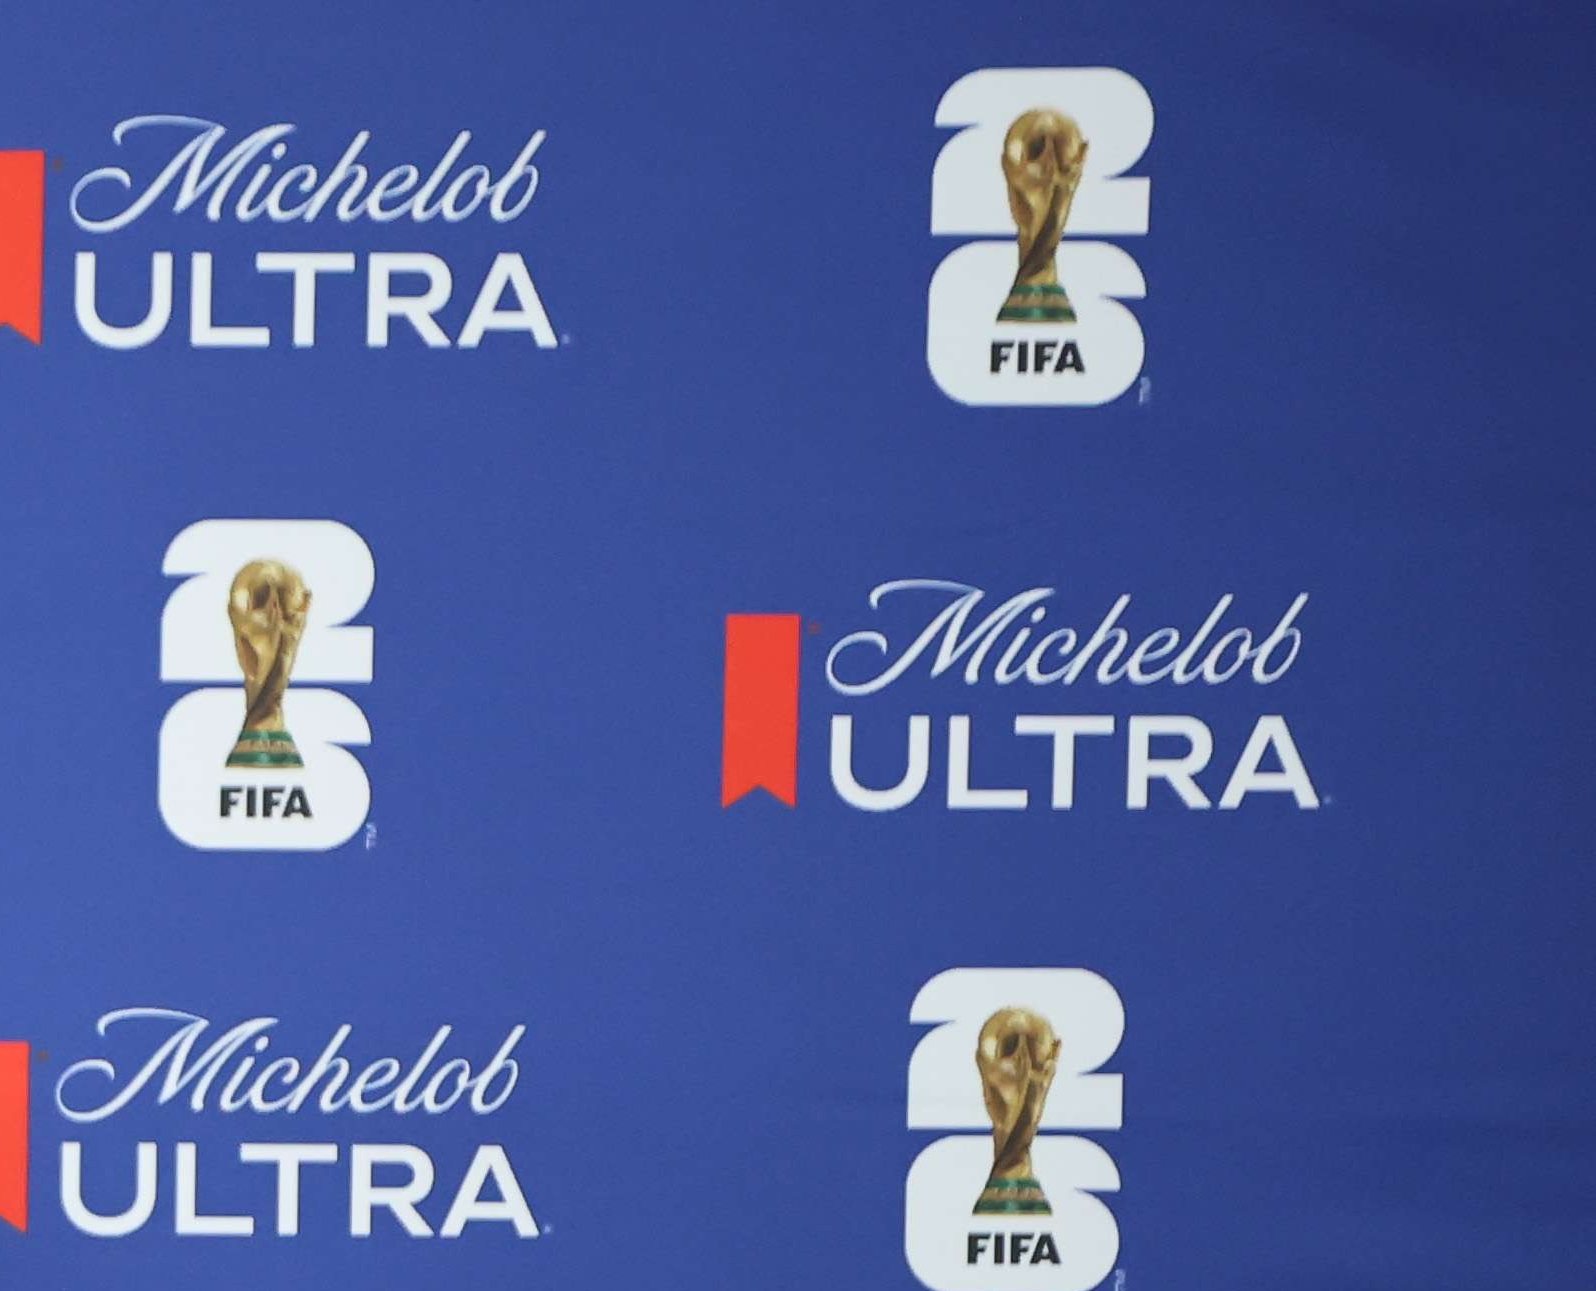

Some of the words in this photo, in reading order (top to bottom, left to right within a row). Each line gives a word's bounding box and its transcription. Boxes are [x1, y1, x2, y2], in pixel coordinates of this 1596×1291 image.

[70, 115, 545, 232] Michelob
[75, 252, 557, 349] ULTRA
[990, 341, 1085, 373] FIFA
[826, 579, 1308, 695] Michelob
[220, 787, 312, 818] FIFA
[830, 715, 1319, 812] ULTRA
[56, 1008, 525, 1122] Michelob
[60, 1141, 539, 1238] ULTRA
[967, 1233, 1061, 1265] FIFA
